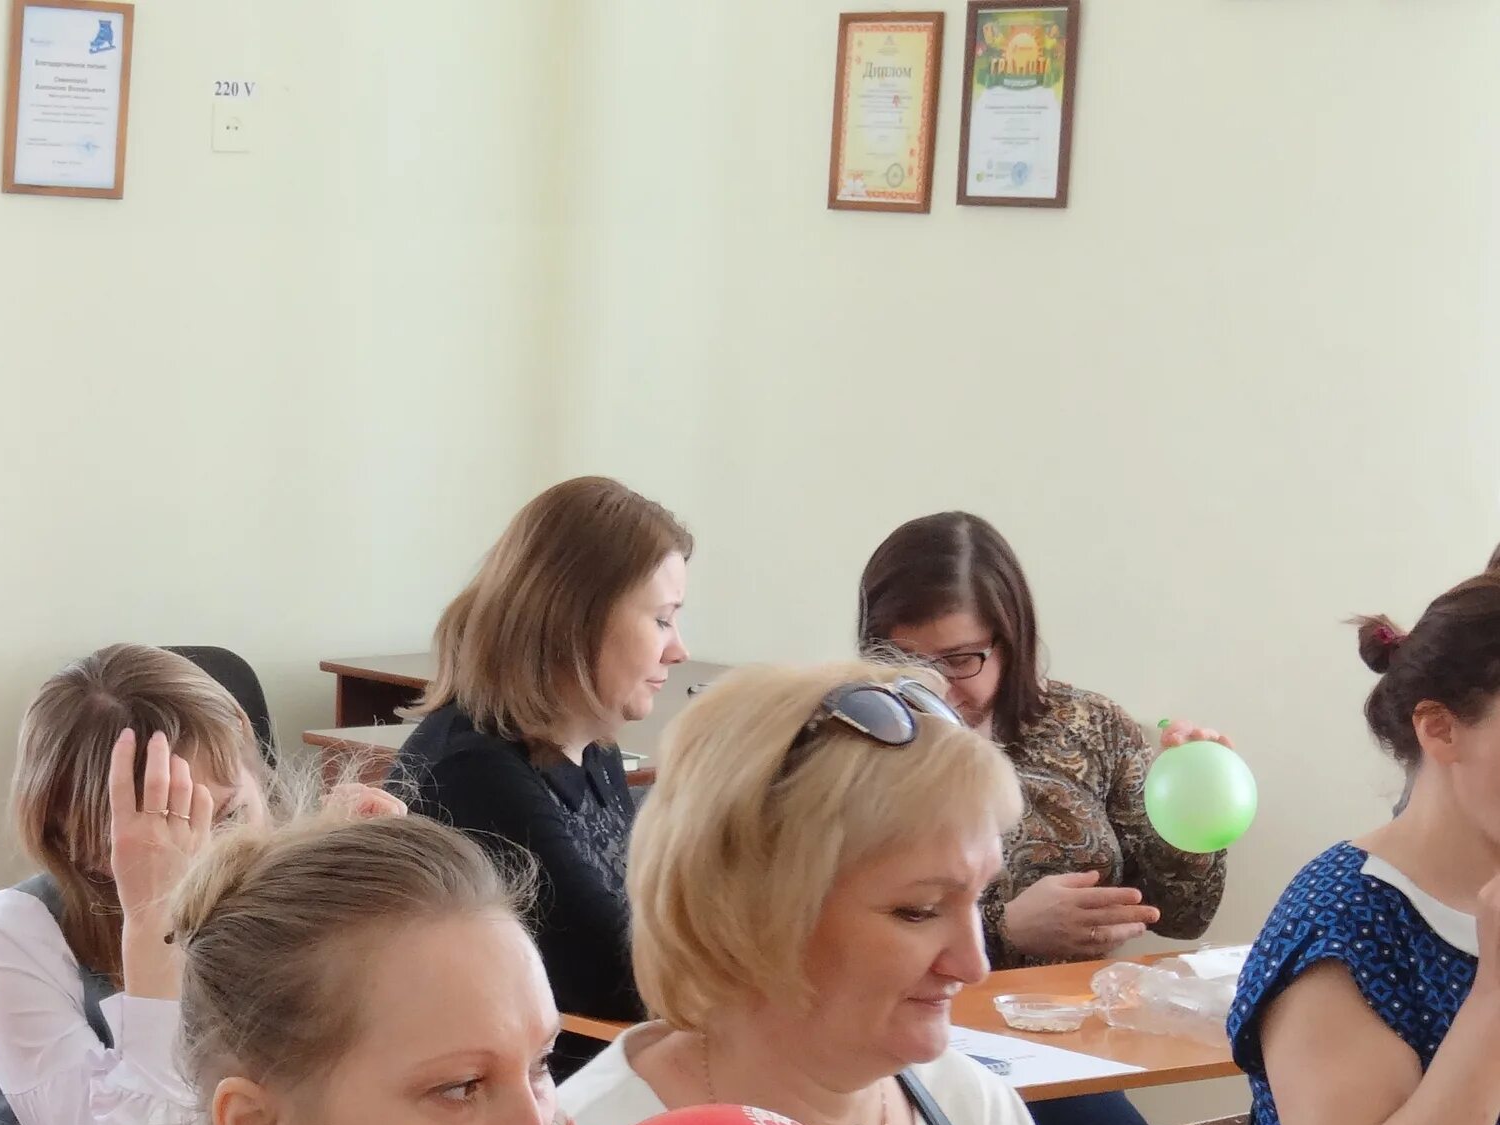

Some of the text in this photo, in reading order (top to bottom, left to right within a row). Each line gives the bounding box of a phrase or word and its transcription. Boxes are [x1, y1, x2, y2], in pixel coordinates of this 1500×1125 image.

[862, 61, 912, 79] Диплом
[214, 80, 255, 97] 220 V
